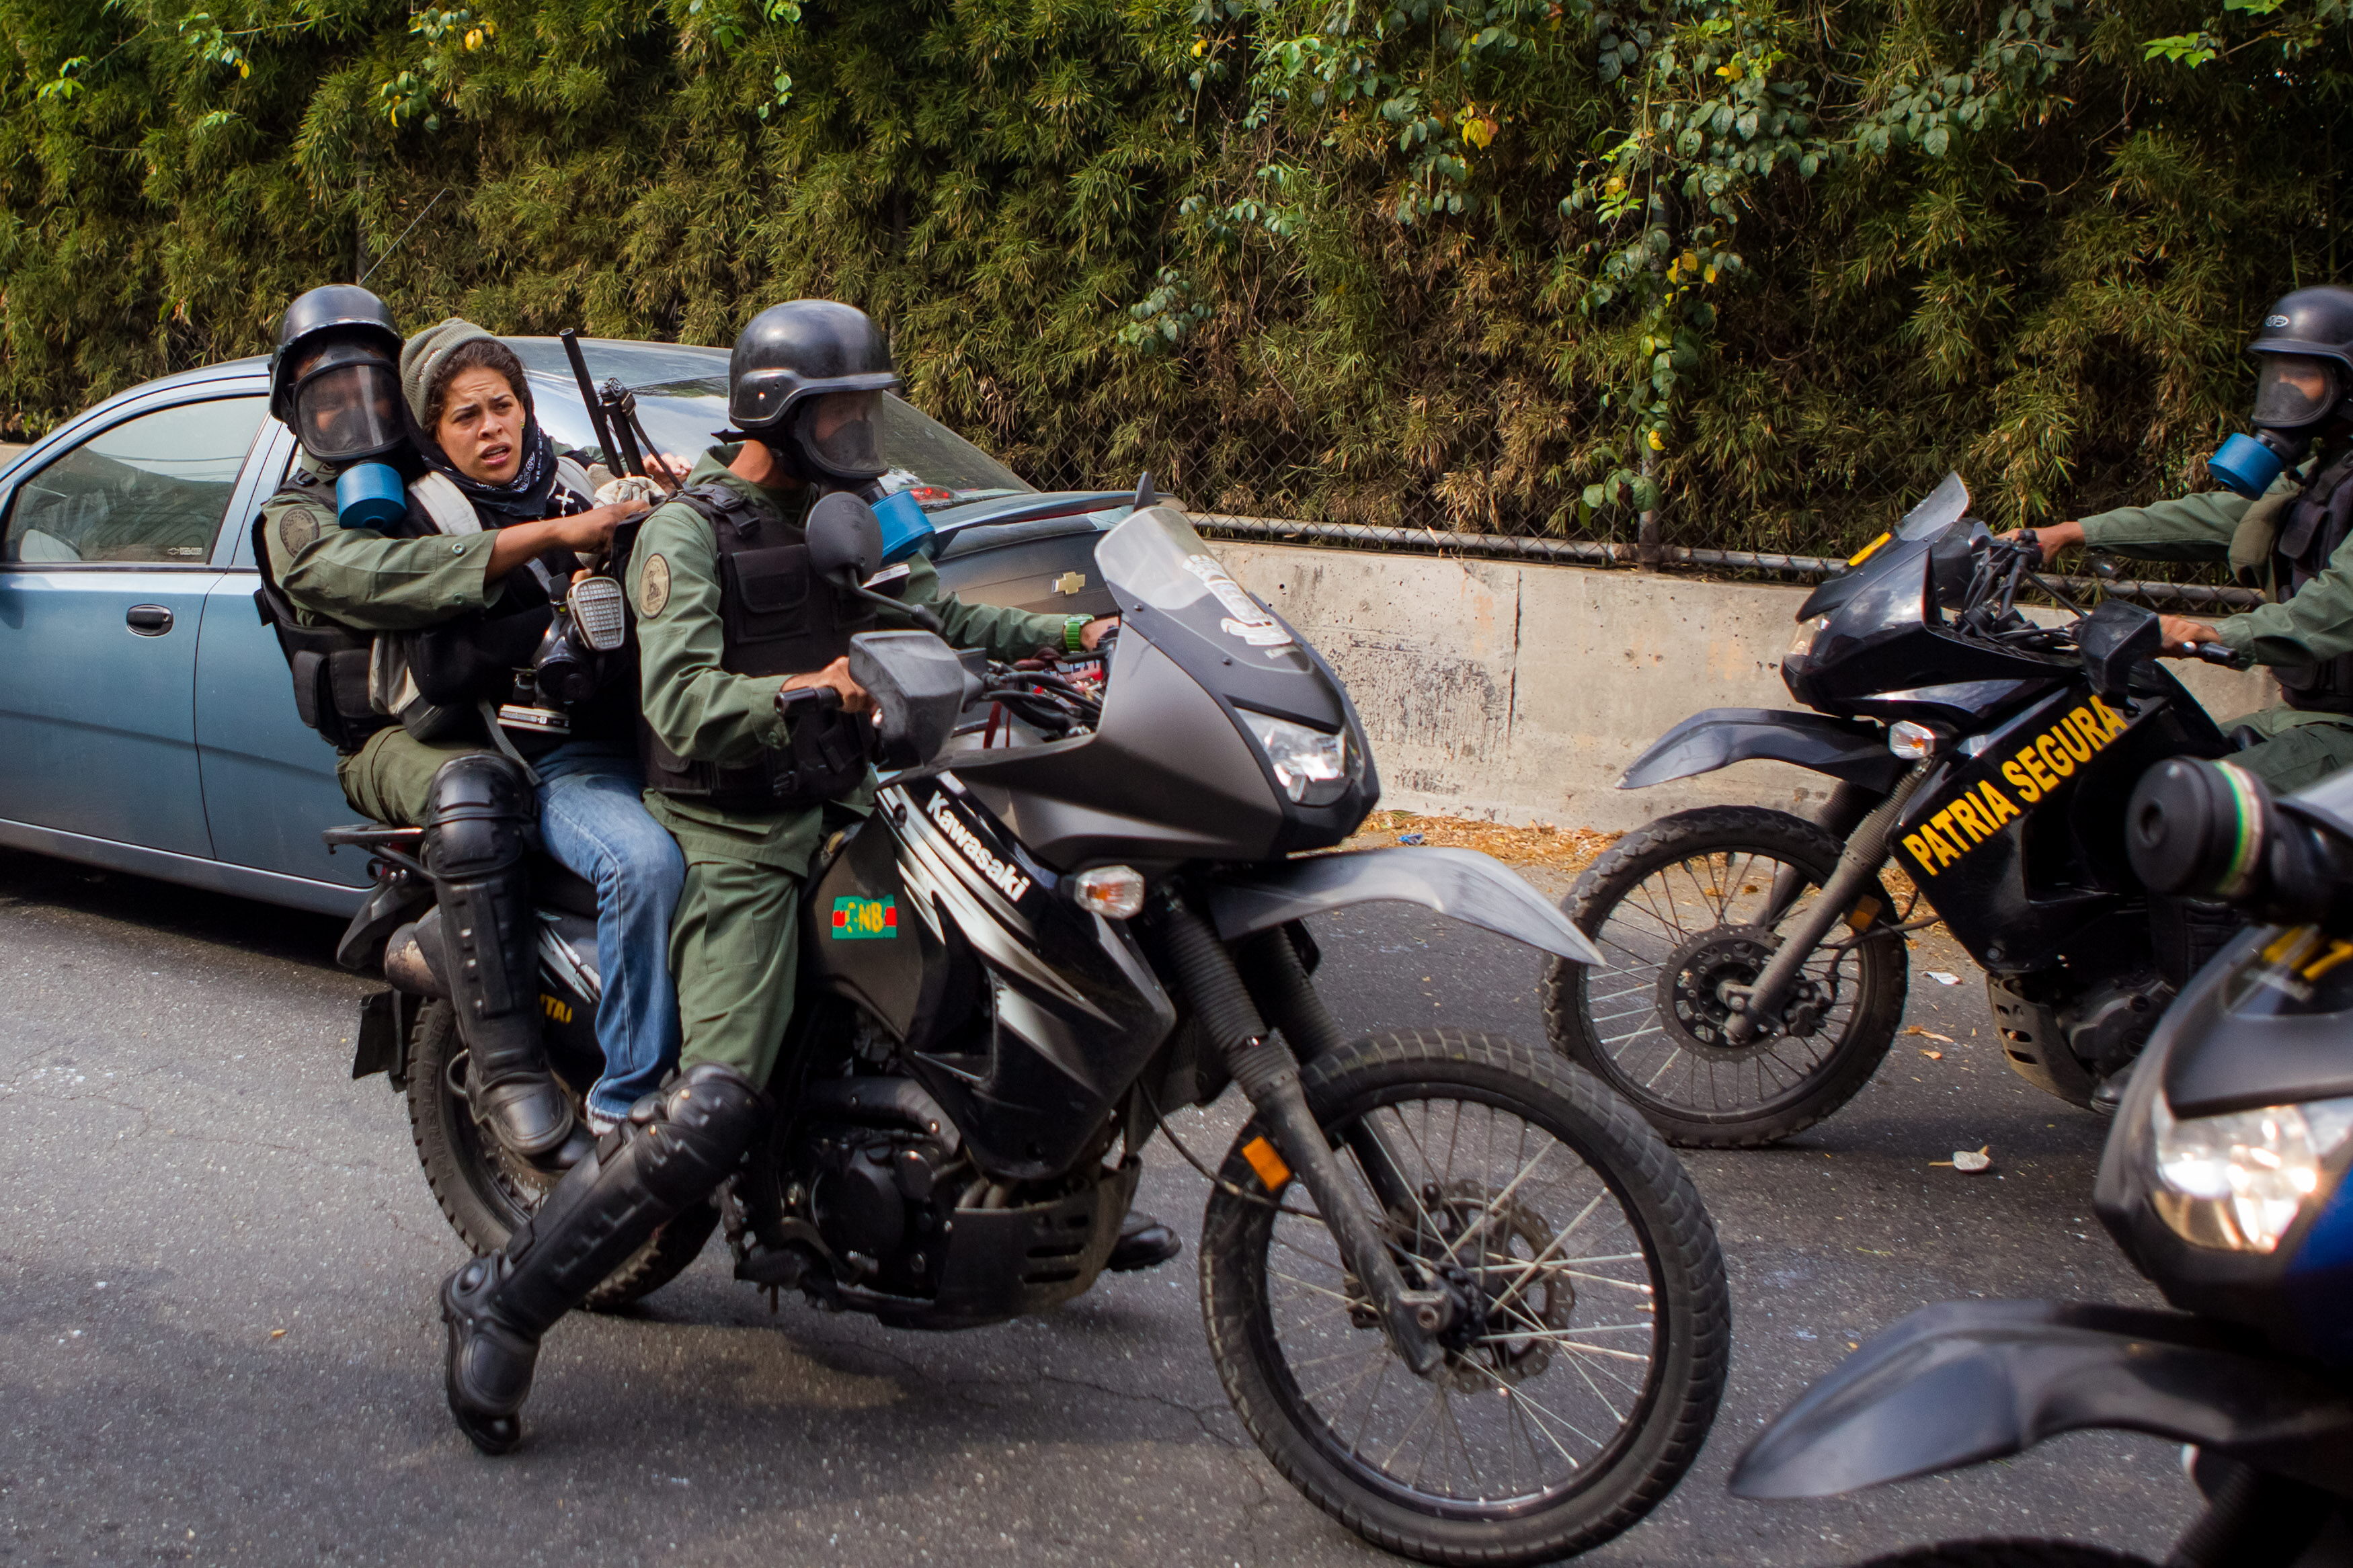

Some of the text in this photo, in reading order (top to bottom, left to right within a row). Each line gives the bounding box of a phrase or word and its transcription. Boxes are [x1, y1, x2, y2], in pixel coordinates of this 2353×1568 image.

[926, 789, 1031, 903] Kawasaki
[1901, 694, 2128, 876] PATRIA SEGURA
